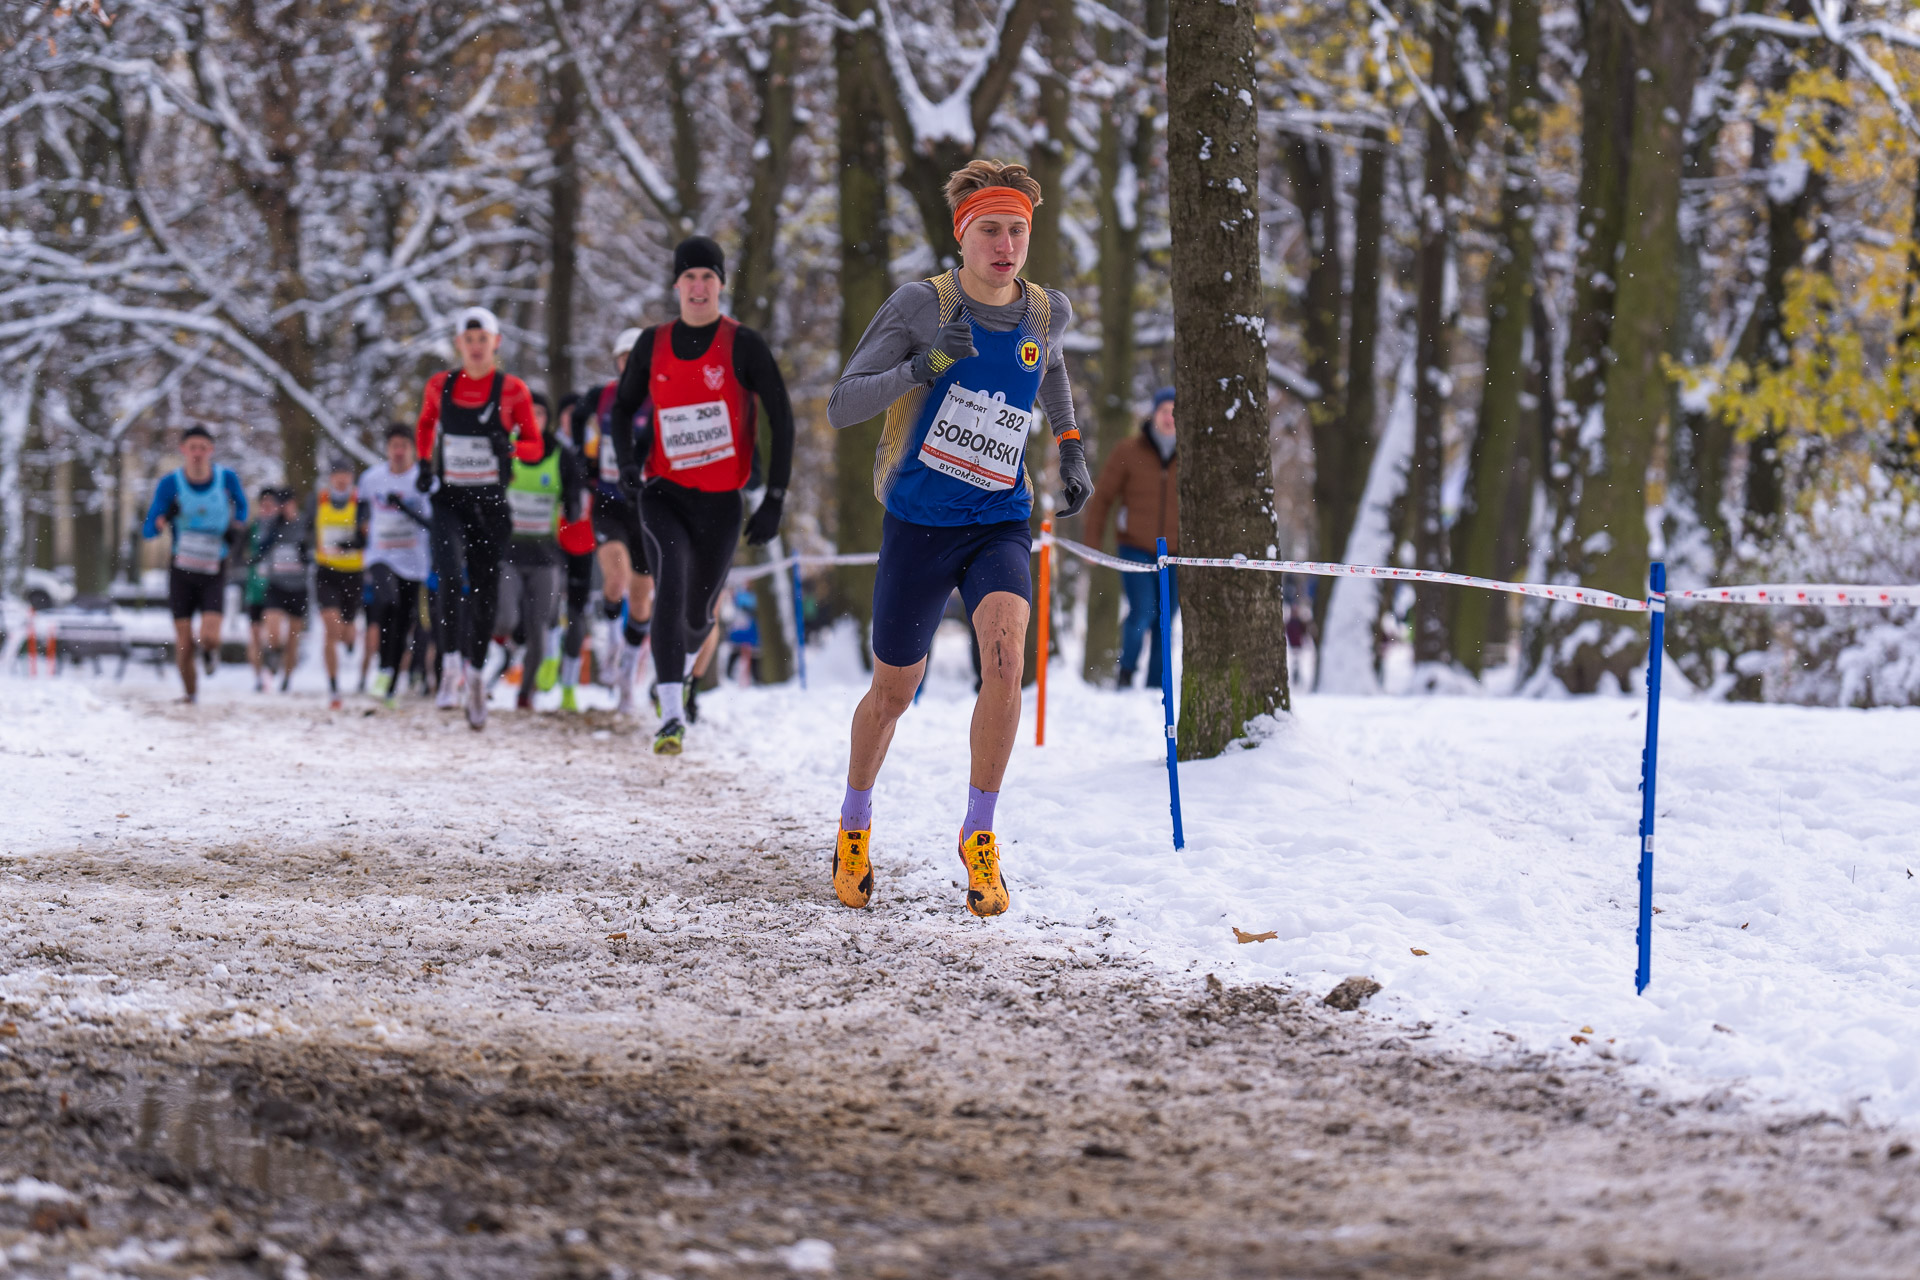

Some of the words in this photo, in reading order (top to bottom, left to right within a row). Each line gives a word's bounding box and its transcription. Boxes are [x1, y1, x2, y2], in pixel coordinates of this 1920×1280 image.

[696, 405, 721, 420] 208
[949, 394, 964, 405] TVP
[964, 400, 988, 414] SPORT
[995, 409, 1025, 433] 282
[933, 419, 1020, 467] SOBORSKI
[938, 462, 970, 480] BYTOM
[969, 471, 992, 488] 2024
